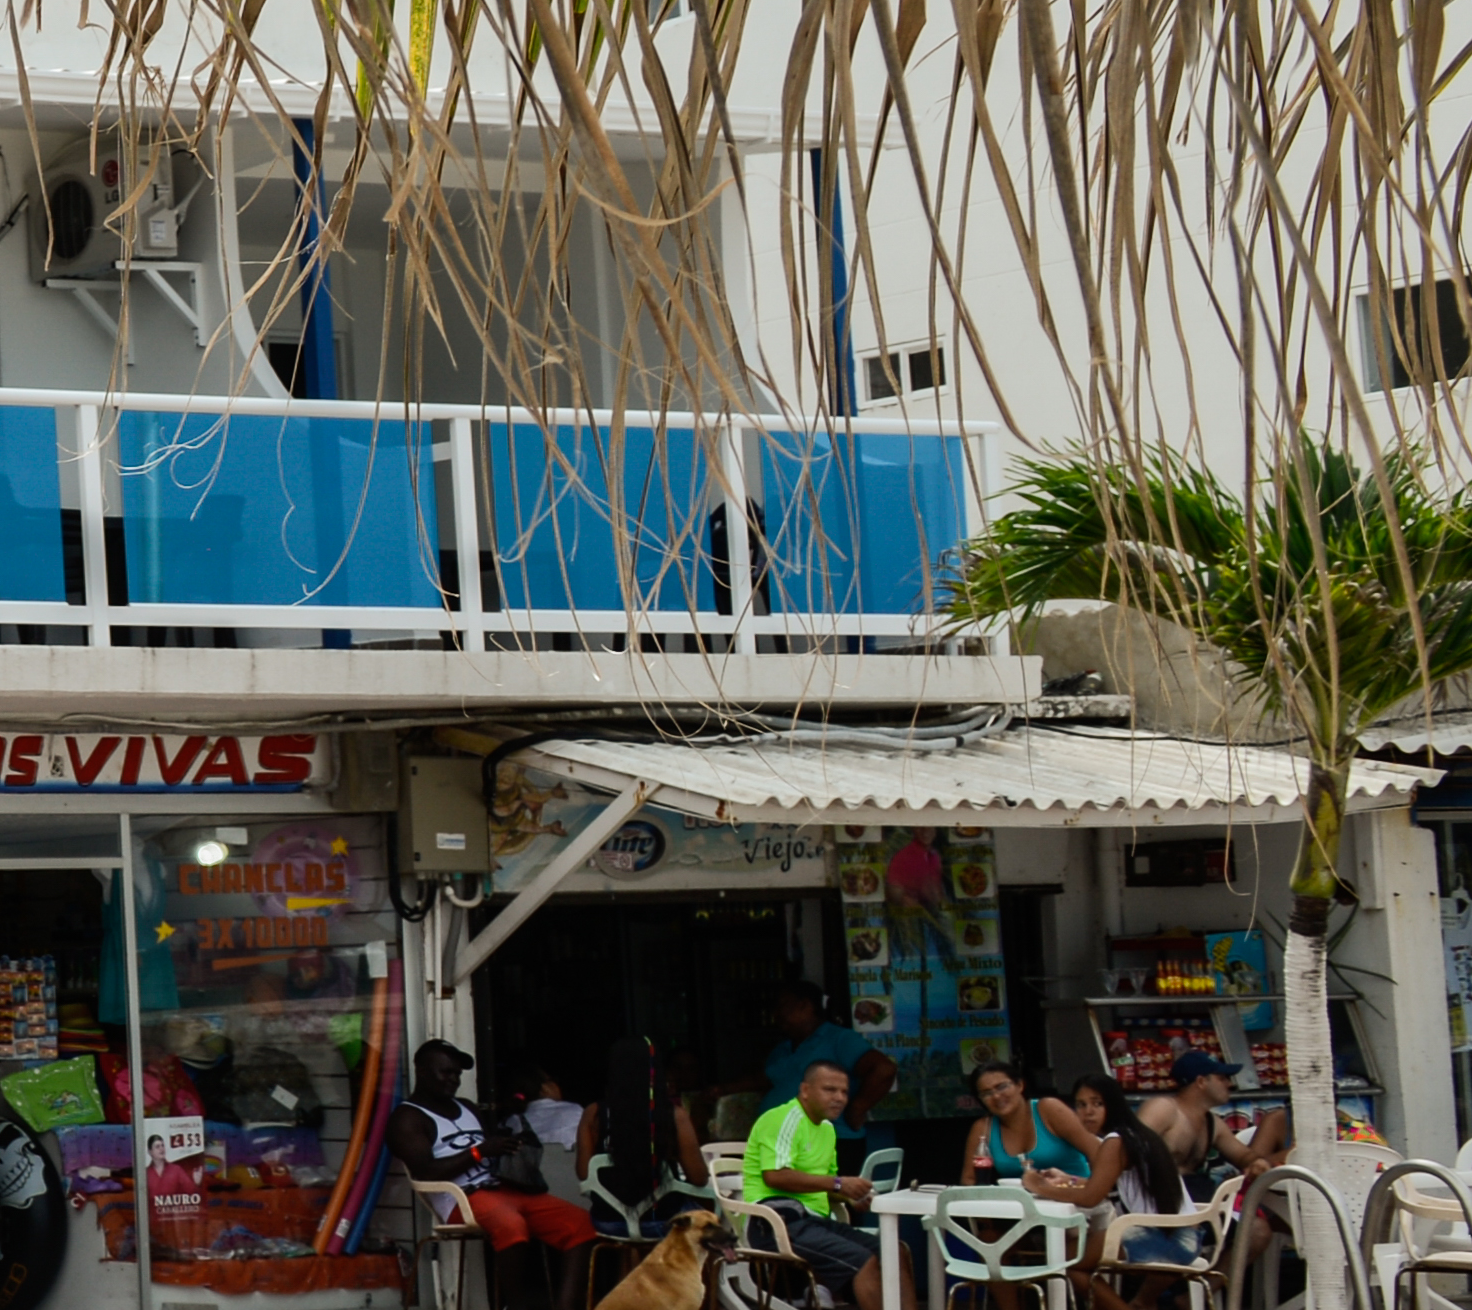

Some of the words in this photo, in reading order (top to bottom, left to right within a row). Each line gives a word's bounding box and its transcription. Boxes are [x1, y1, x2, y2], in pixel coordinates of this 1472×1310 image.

[65, 734, 317, 786] VIVAS
[179, 863, 345, 894] CHANCLAS
[154, 1193, 201, 1207] NAURO
